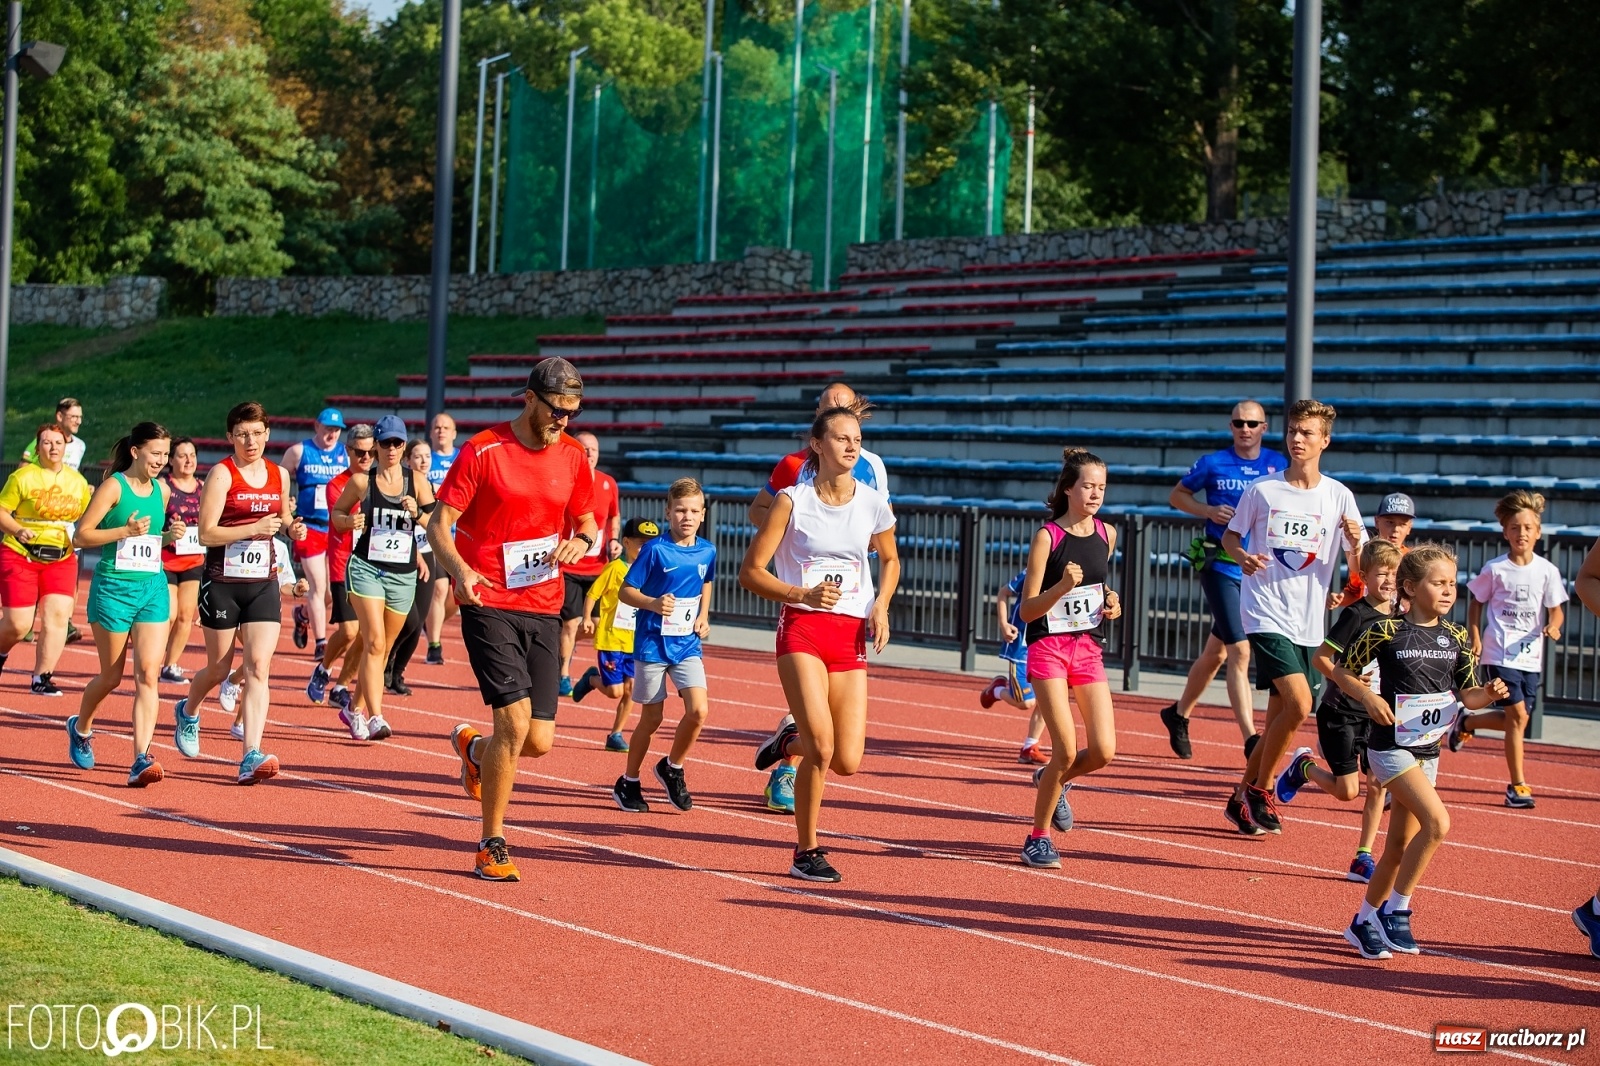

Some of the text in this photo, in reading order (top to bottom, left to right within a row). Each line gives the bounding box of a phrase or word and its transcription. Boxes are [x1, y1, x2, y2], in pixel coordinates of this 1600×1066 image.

[237, 493, 280, 501] DAR-BUD
[373, 507, 412, 532] LET'S
[1284, 521, 1309, 537] 158
[386, 539, 399, 550] 25
[132, 544, 152, 558] 110
[240, 551, 261, 564] 109
[1064, 598, 1090, 616] 151
[684, 609, 691, 621] 6
[1502, 609, 1518, 618] RUN
[1396, 648, 1457, 660] RUNMAGEDDON
[1520, 642, 1531, 654] 15
[1421, 708, 1441, 726] 80
